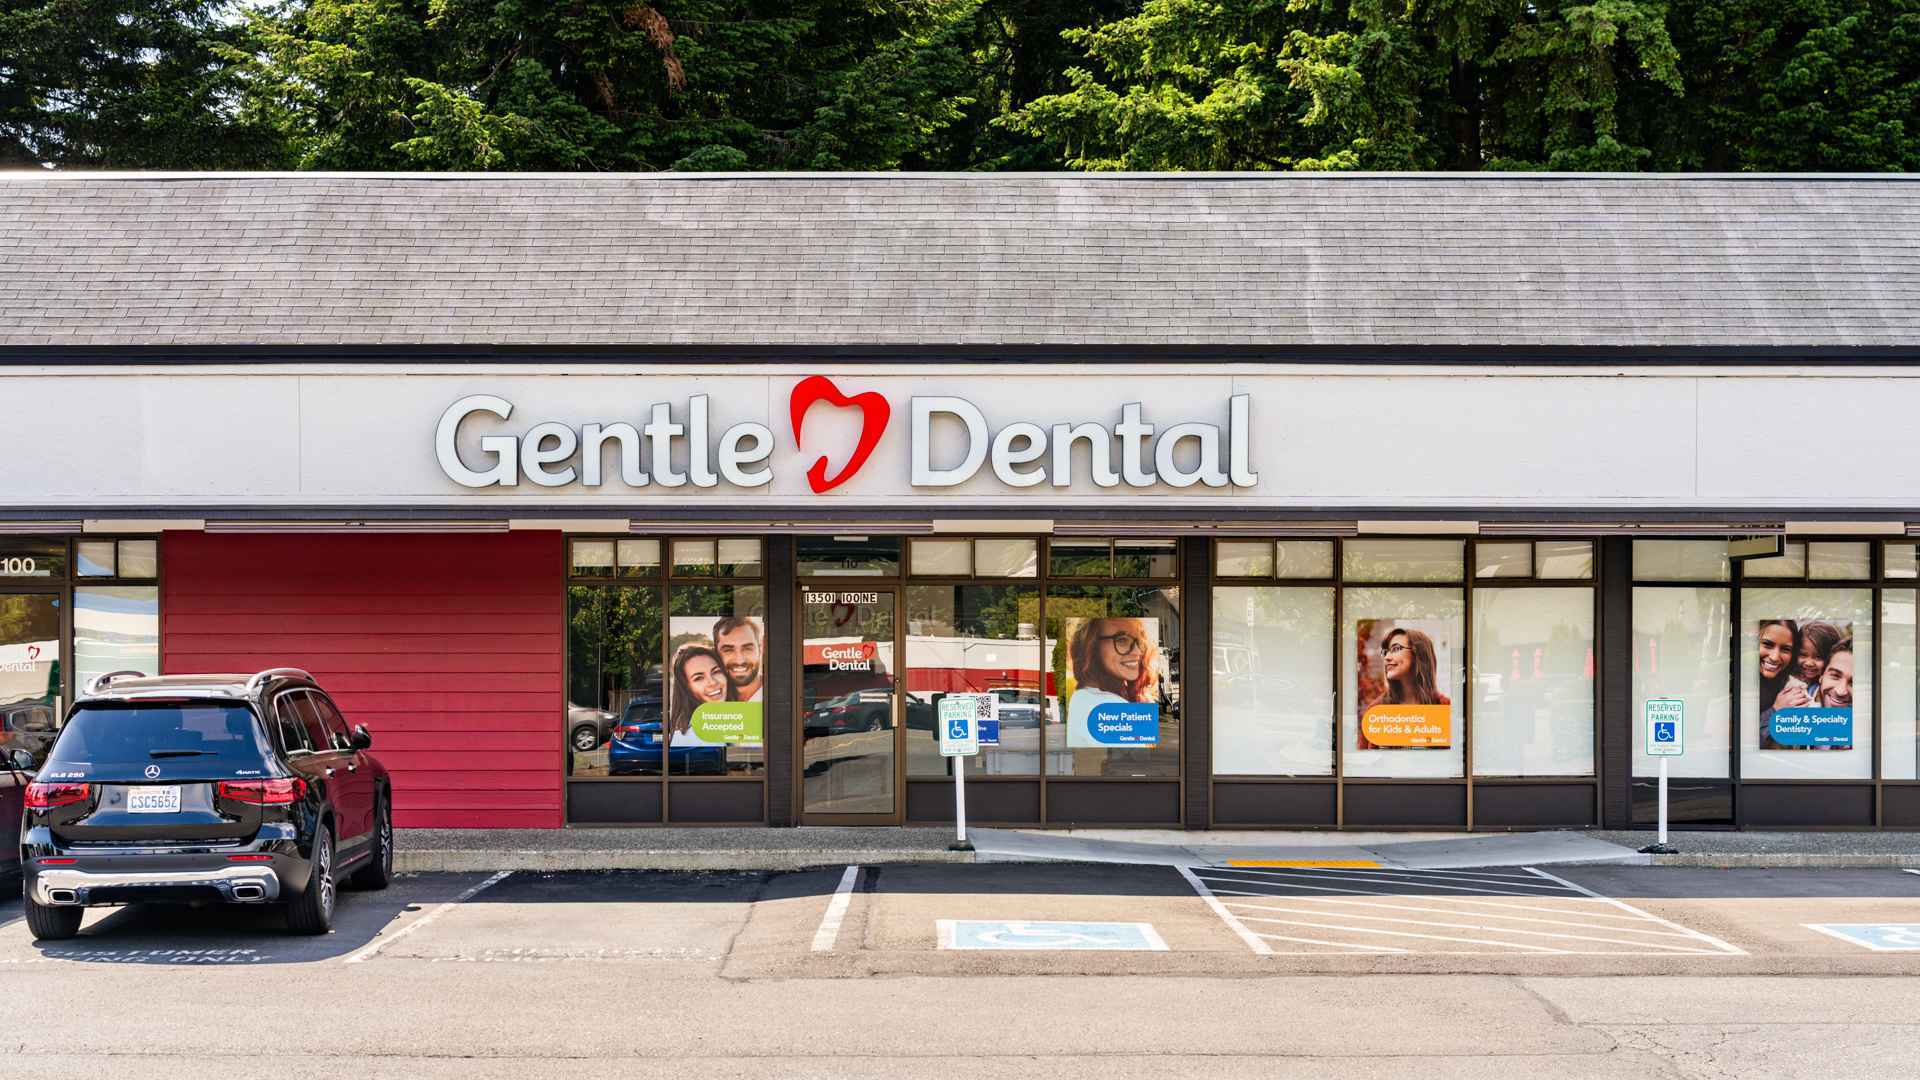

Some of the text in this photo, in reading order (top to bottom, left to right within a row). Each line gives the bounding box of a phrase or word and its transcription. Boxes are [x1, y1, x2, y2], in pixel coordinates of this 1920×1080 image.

[434, 394, 1258, 488] Gentle Dental
[1, 558, 35, 574] 100
[822, 647, 863, 659] Gentle
[829, 659, 871, 671] Dental
[702, 712, 743, 721] Insurance
[1098, 712, 1152, 721] New Patient
[1368, 714, 1425, 723] Orthodontics
[1775, 714, 1849, 726] Family & Specialty
[702, 722, 744, 732] Accepted
[1098, 722, 1132, 733] Specials
[1368, 725, 1442, 734] for Kids & Adults
[1775, 725, 1813, 735] Dentistry
